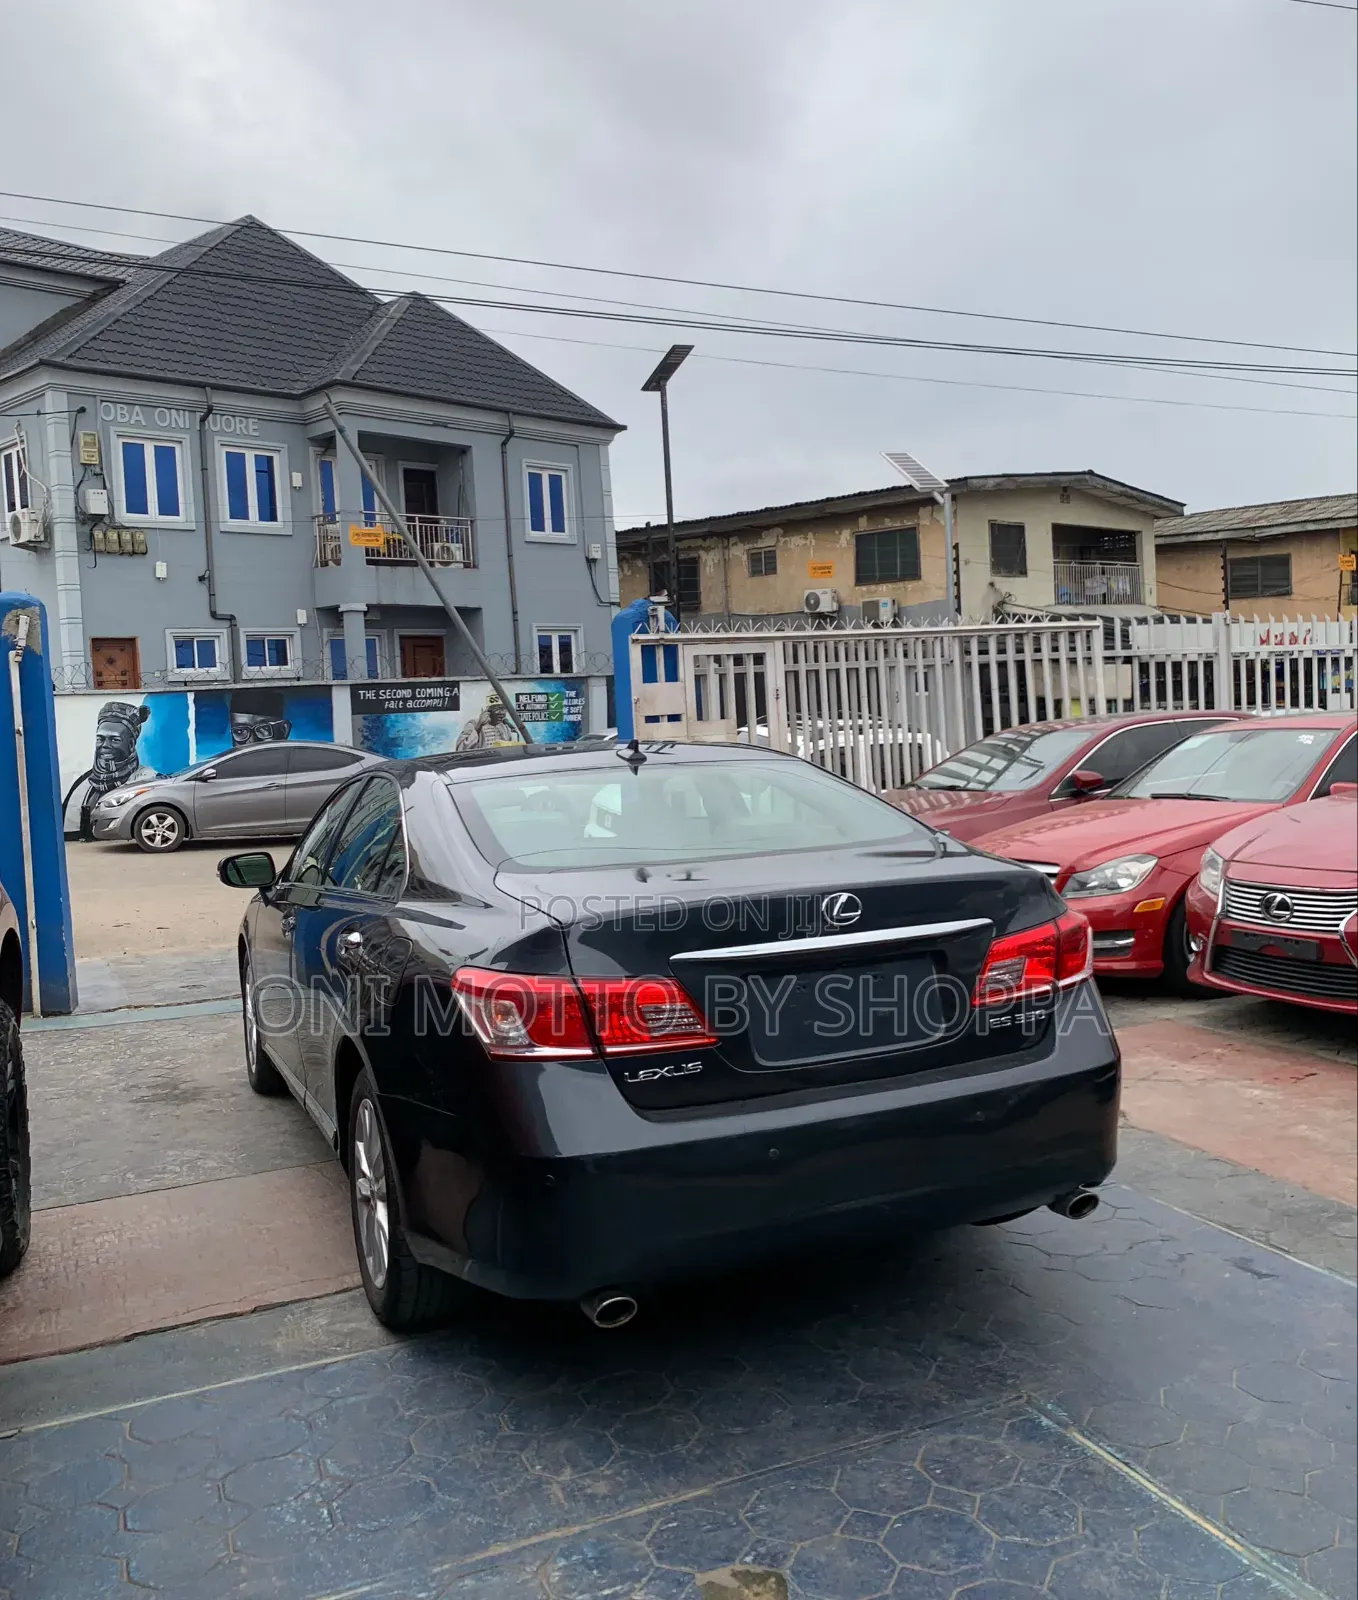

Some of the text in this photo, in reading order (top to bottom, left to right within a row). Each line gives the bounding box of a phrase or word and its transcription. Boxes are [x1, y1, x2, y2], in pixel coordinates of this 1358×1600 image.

[100, 402, 147, 426] OBA
[154, 407, 190, 429] ONI
[358, 690, 377, 700] THE
[379, 688, 412, 699] SECOND
[518, 712, 532, 721] TATE
[623, 1061, 703, 1083] LEXUS
